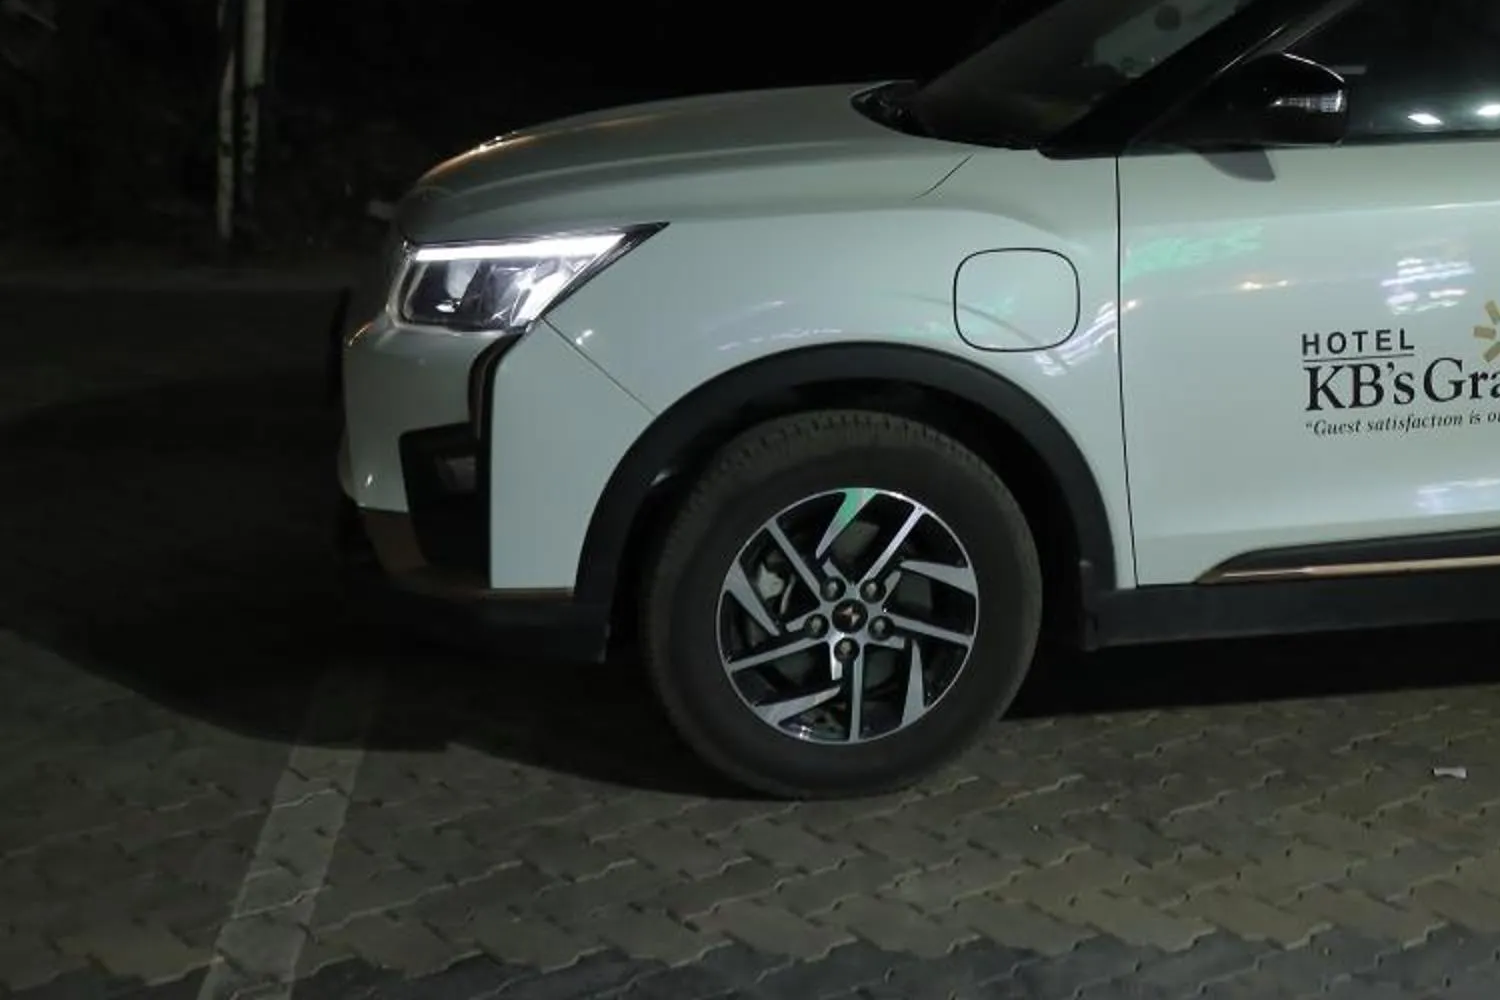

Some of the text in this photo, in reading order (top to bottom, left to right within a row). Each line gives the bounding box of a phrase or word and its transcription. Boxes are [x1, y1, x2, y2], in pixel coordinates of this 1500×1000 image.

[1301, 329, 1414, 356] HOTEL
[1367, 413, 1464, 434] satisfaction
[1469, 409, 1481, 426] is
